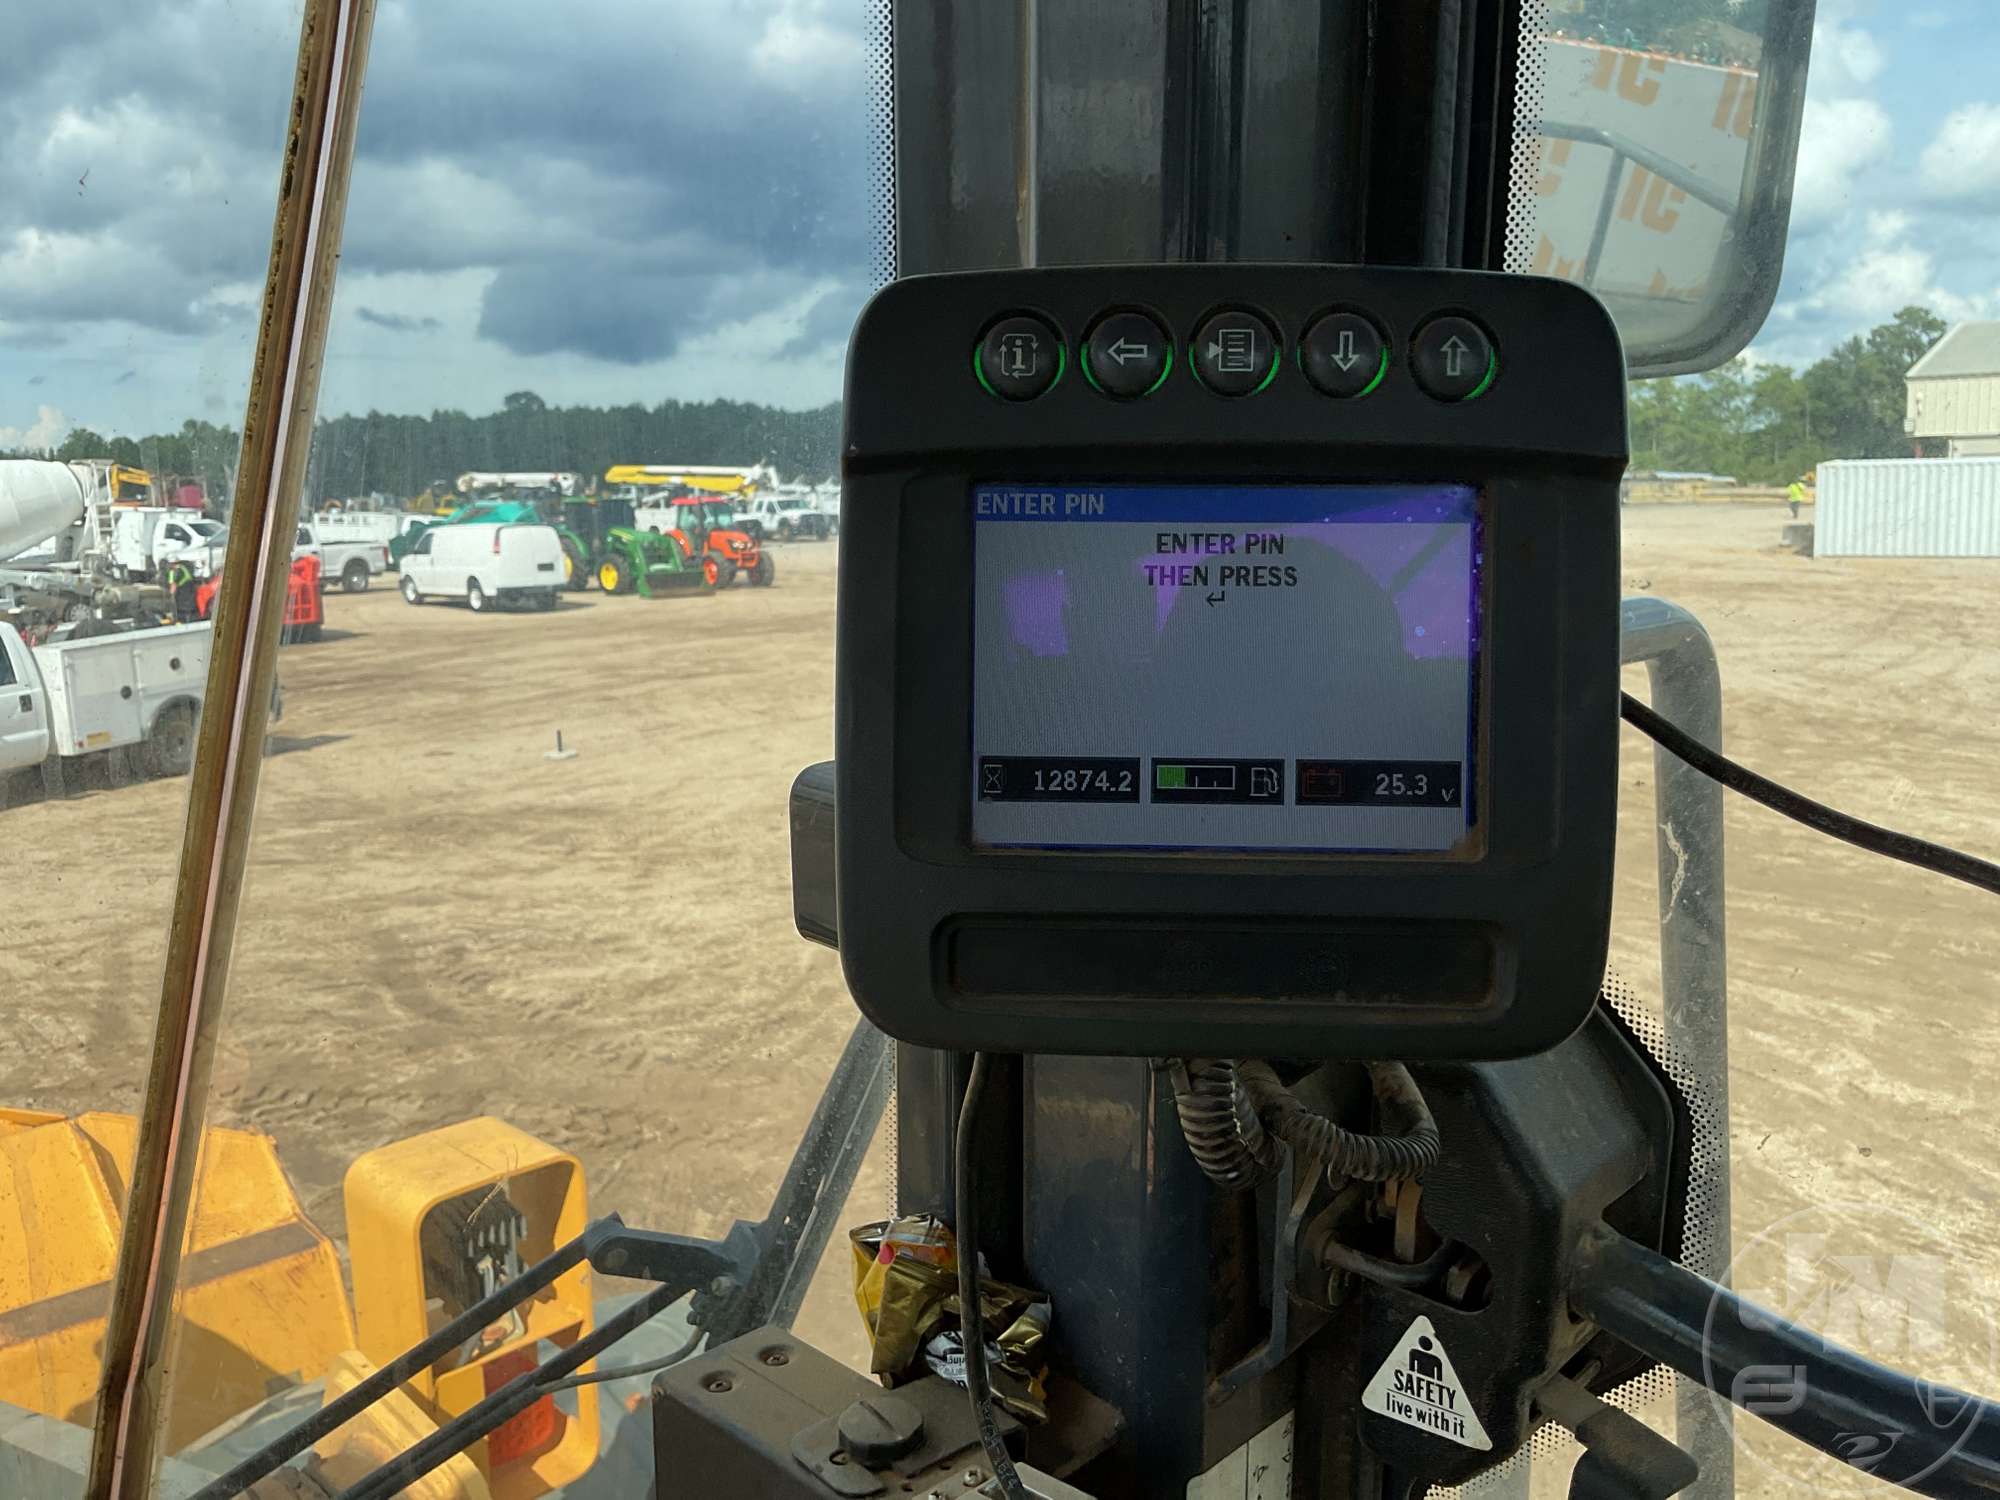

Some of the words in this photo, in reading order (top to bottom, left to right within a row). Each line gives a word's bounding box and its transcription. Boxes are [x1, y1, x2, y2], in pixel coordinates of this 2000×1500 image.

[977, 493, 1055, 515] ENTER
[1064, 493, 1105, 515] PIN
[1156, 533, 1236, 554] ENTER
[1244, 533, 1285, 555] PIN
[1143, 564, 1209, 586] THEN
[1219, 565, 1298, 587] PRESS
[1034, 769, 1132, 792] 12874.2
[1375, 773, 1428, 795] 25.3
[1394, 1369, 1456, 1410] SAFETY
[1386, 1392, 1412, 1418] live
[1415, 1408, 1450, 1432] with
[1453, 1417, 1465, 1438] it
